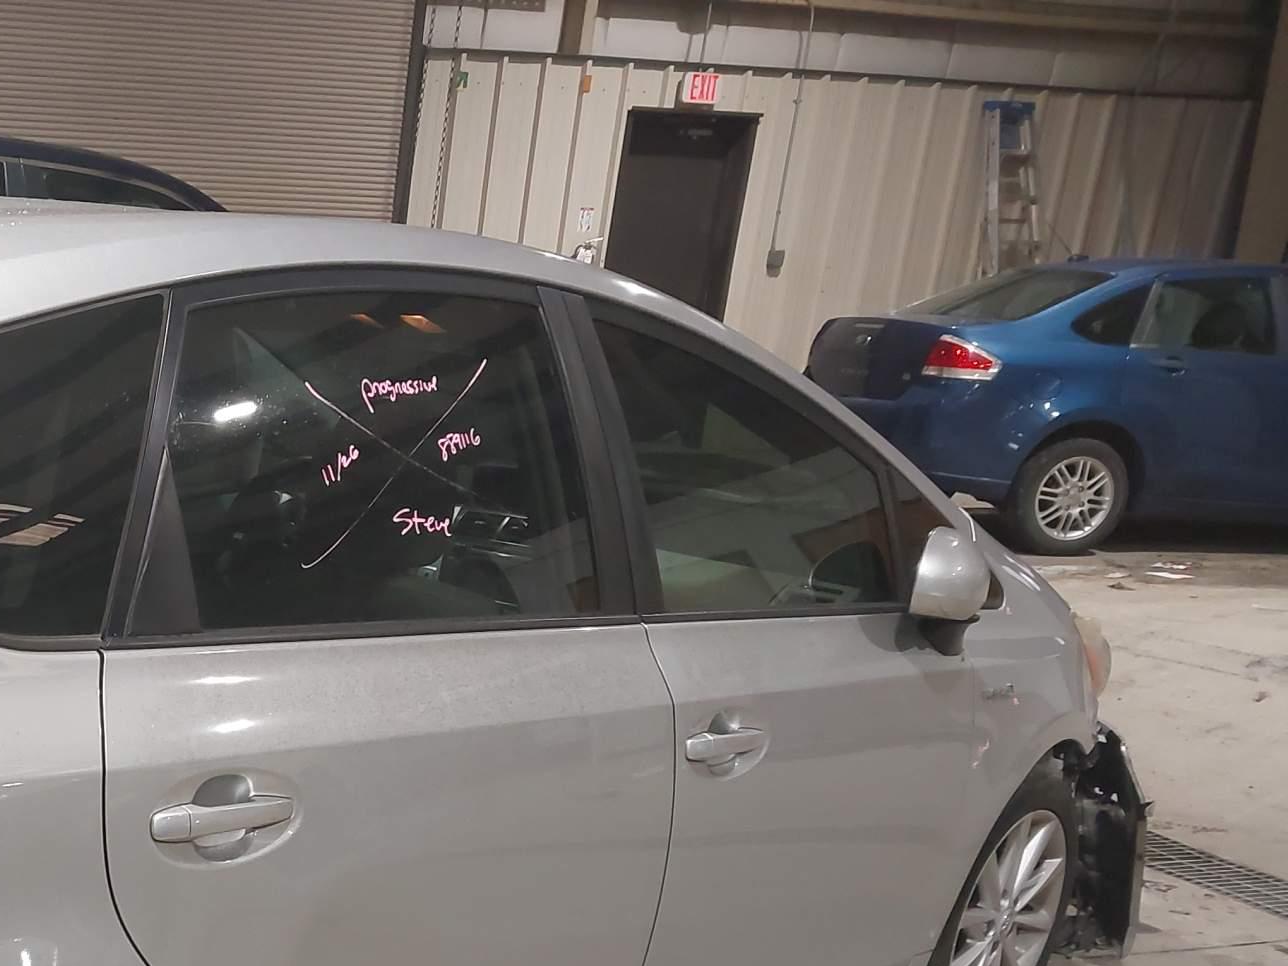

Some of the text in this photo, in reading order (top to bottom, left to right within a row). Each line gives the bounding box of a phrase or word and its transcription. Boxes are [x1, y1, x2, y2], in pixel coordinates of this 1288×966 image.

[690, 74, 719, 101] EXIT
[321, 444, 360, 487] 11/26
[392, 508, 452, 537] Steve
